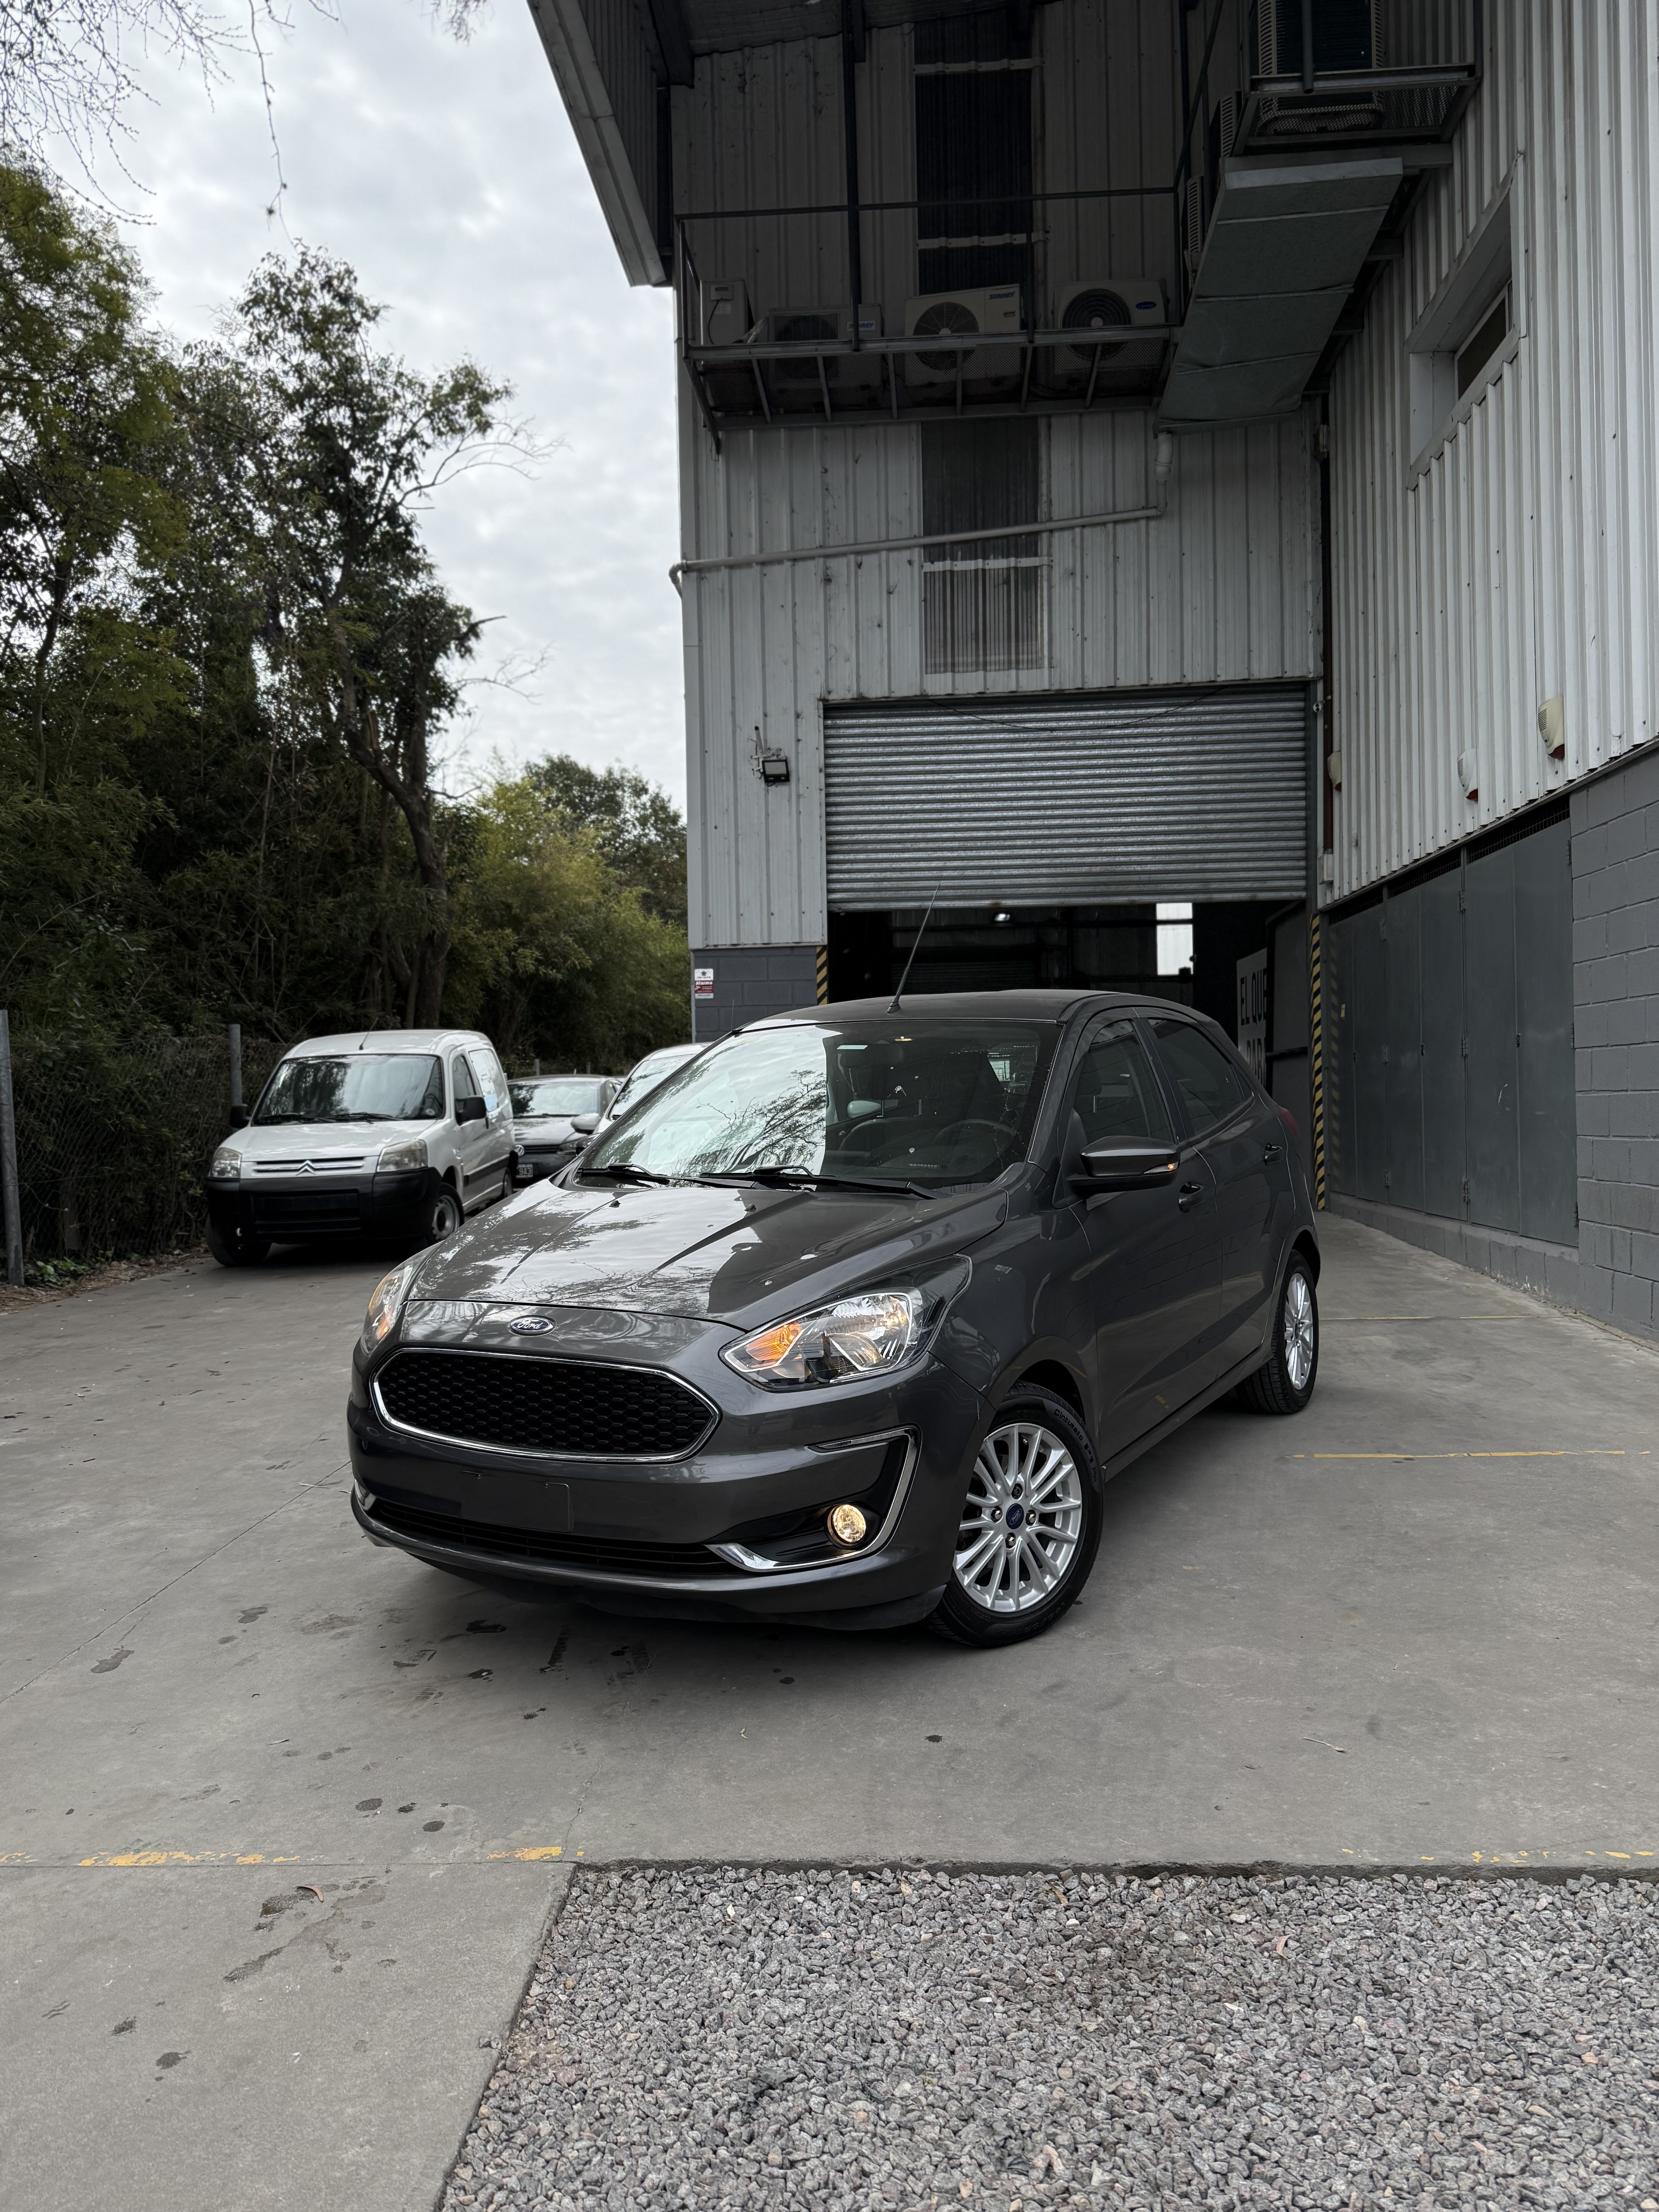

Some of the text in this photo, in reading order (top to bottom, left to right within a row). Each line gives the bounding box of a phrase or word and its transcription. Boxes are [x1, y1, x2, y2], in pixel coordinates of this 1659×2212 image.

[989, 291, 1015, 299] SURREY
[1240, 975, 1250, 1025] EL
[517, 1318, 543, 1329] Ford
